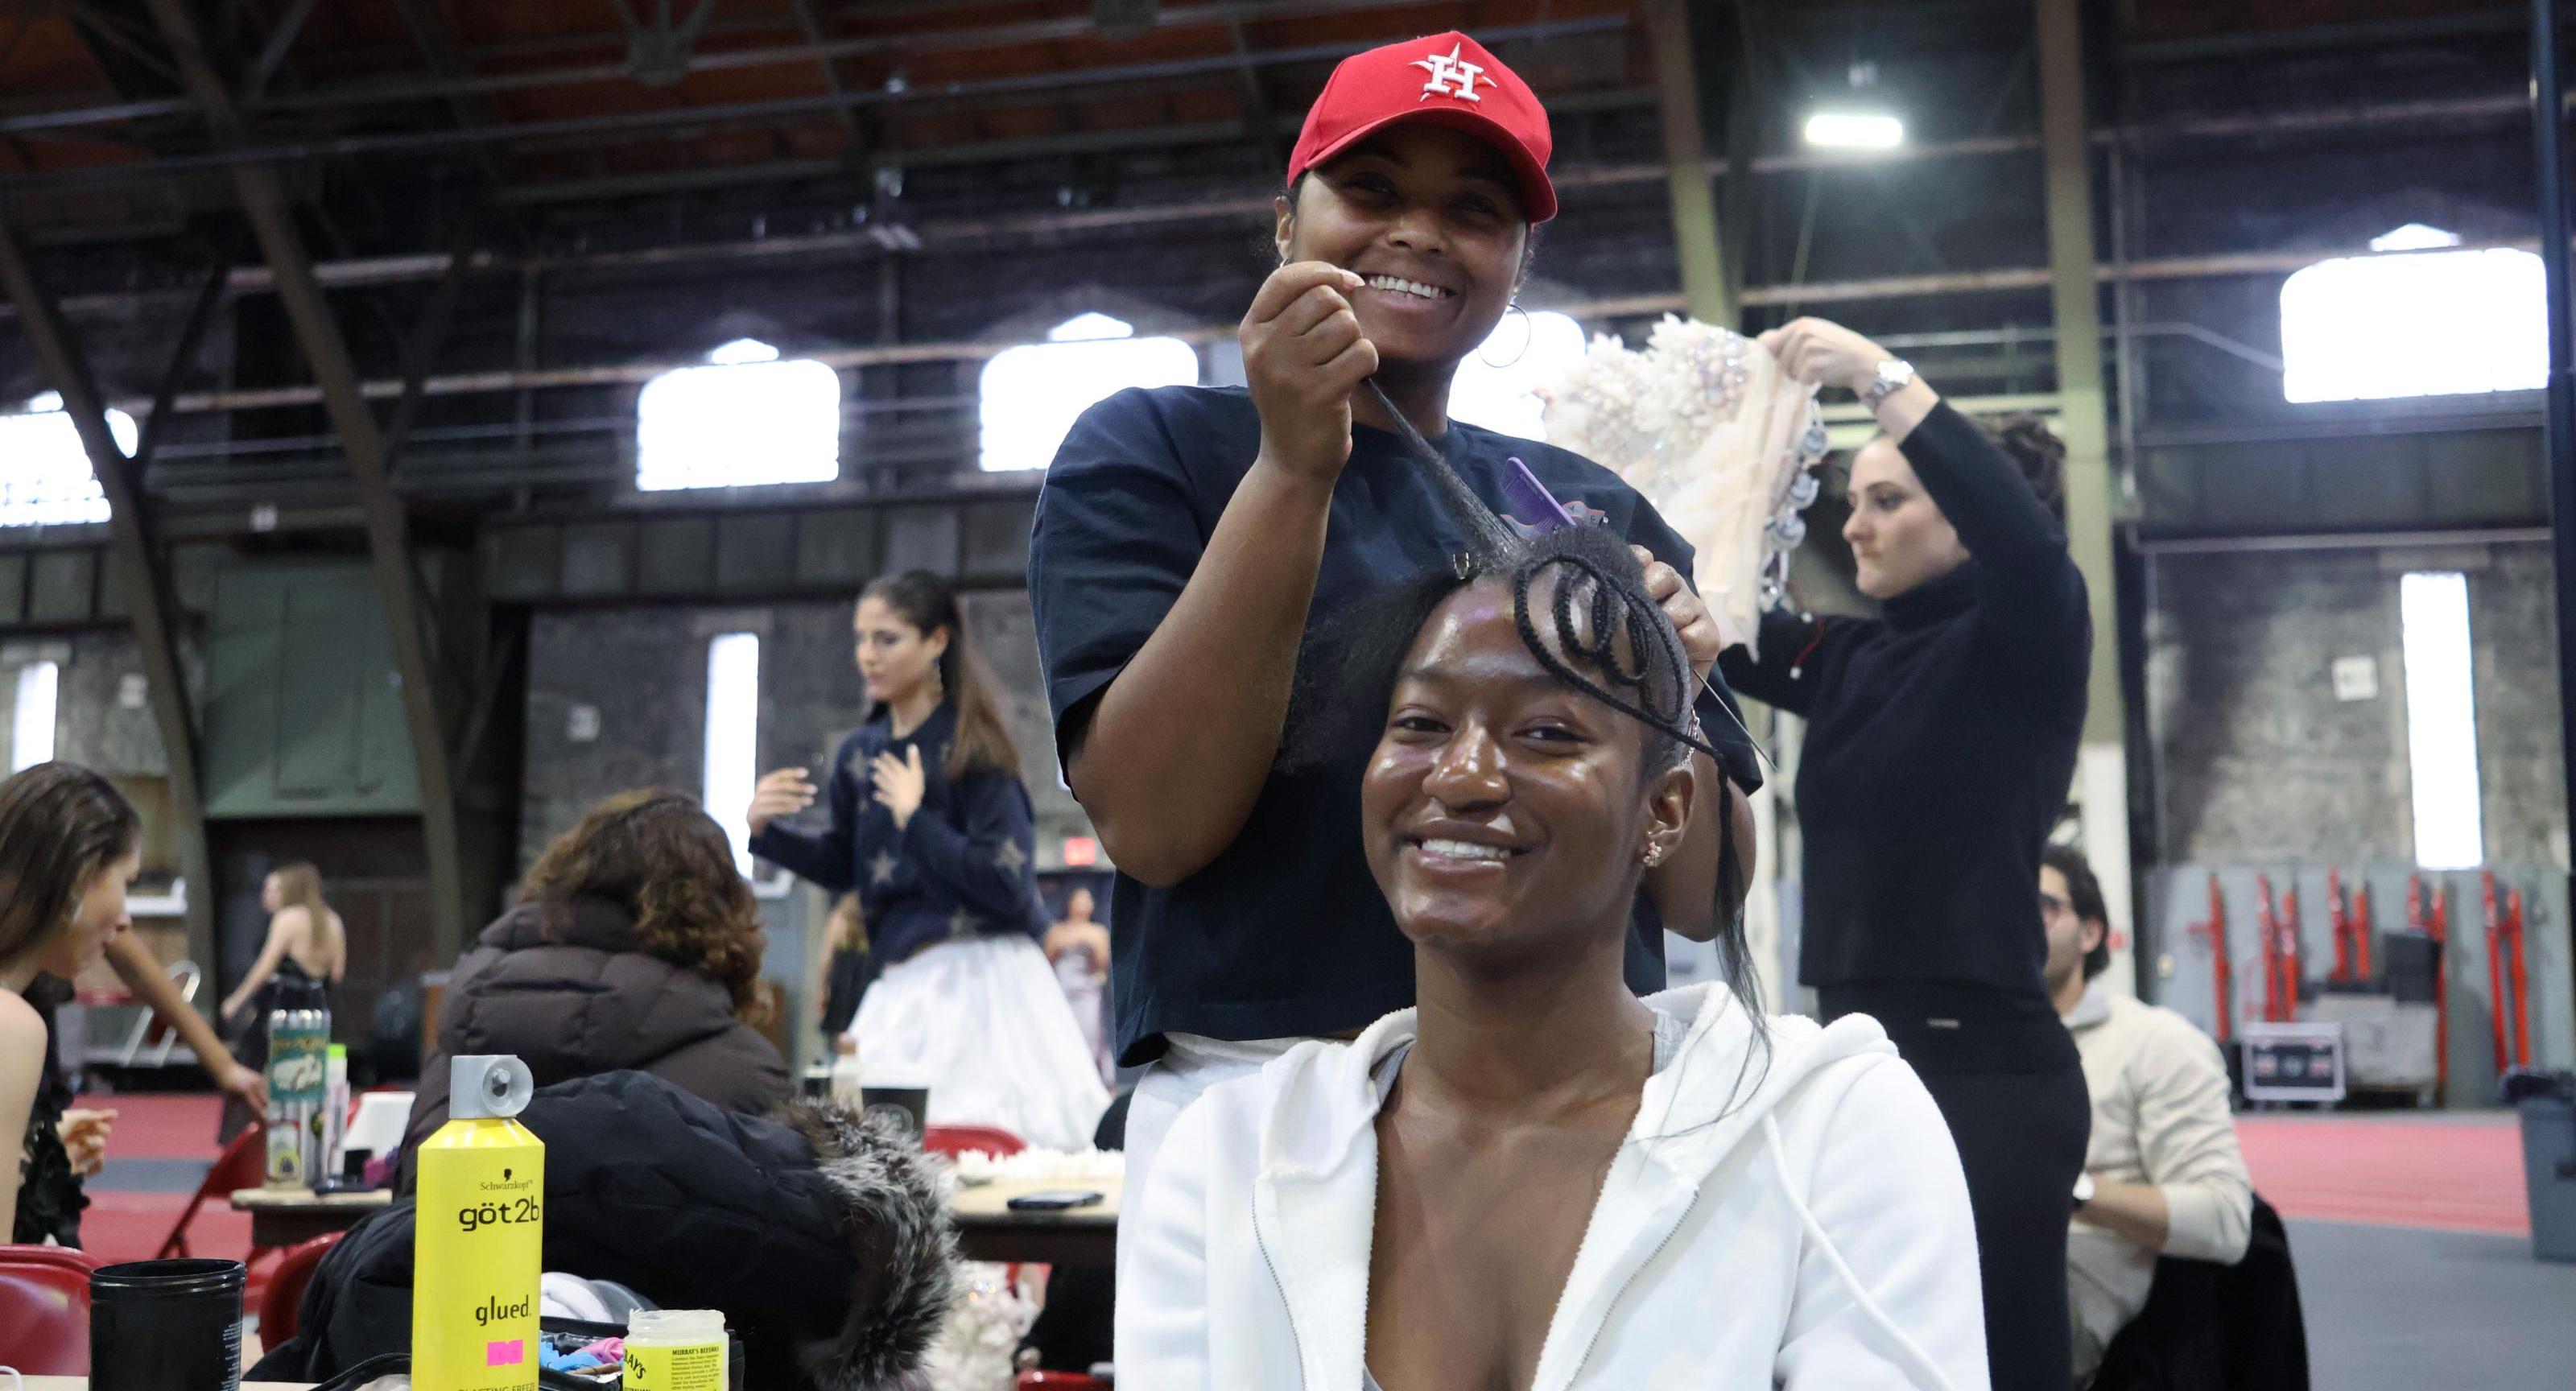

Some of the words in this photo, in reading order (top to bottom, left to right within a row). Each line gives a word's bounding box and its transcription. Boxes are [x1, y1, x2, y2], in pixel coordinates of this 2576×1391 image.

[1423, 54, 1484, 102] H
[480, 1179, 530, 1191] Schwarzkopf
[459, 1195, 540, 1232] göt2b
